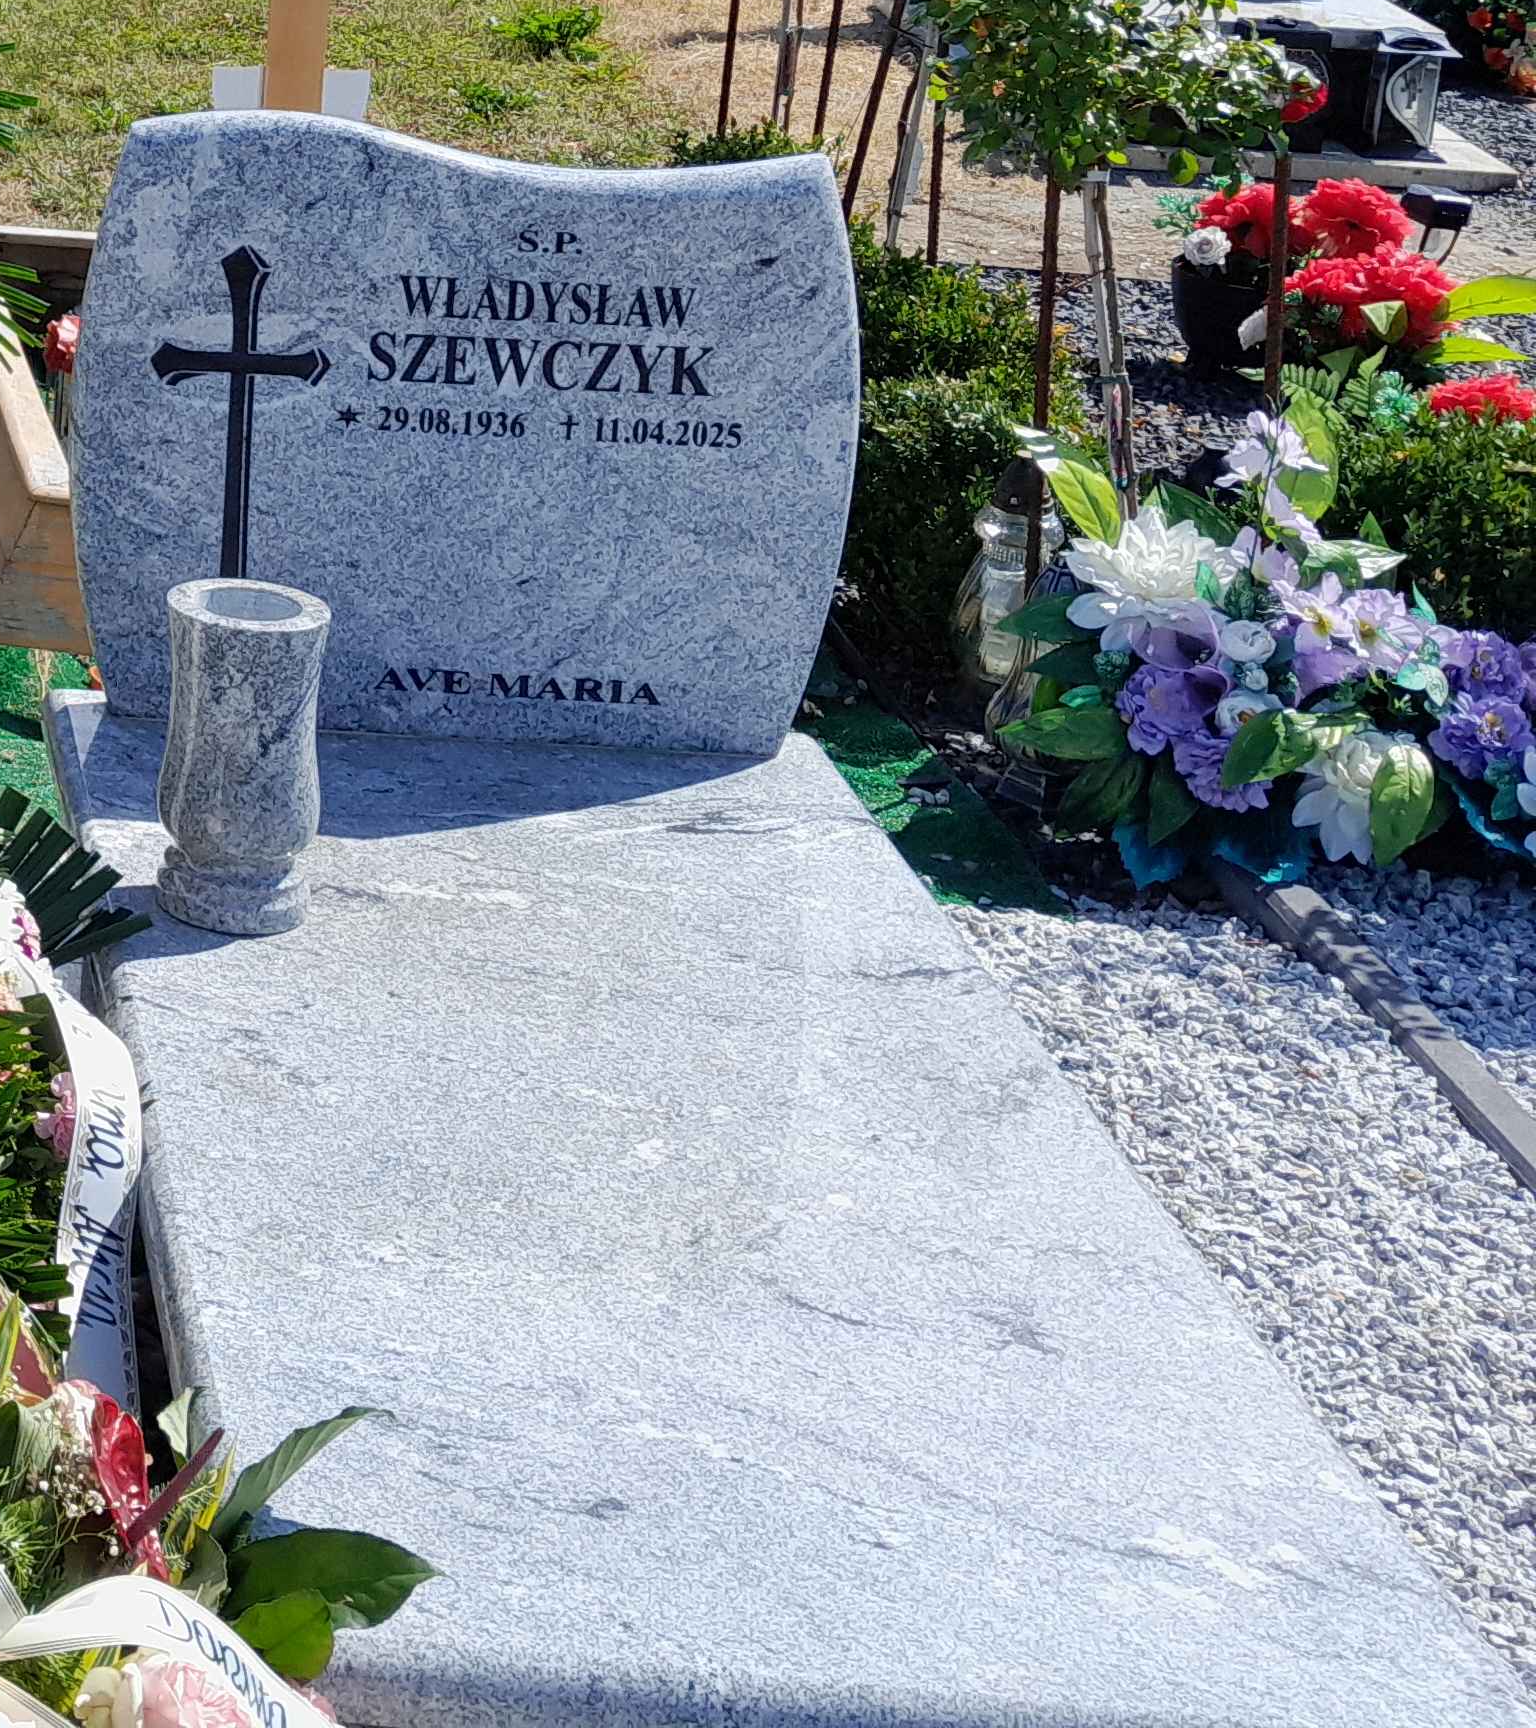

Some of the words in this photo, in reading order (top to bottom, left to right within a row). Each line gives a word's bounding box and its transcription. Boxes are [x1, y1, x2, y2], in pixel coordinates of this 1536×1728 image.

[517, 224, 582, 254] Ś.P.
[400, 274, 696, 328] WŁADYSŁAW
[368, 330, 715, 396] SZEWCZYK
[377, 405, 525, 438] 29.08.1936
[595, 415, 743, 449] 11.04.2025
[375, 667, 471, 695] AVE
[487, 673, 661, 706] MARIA
